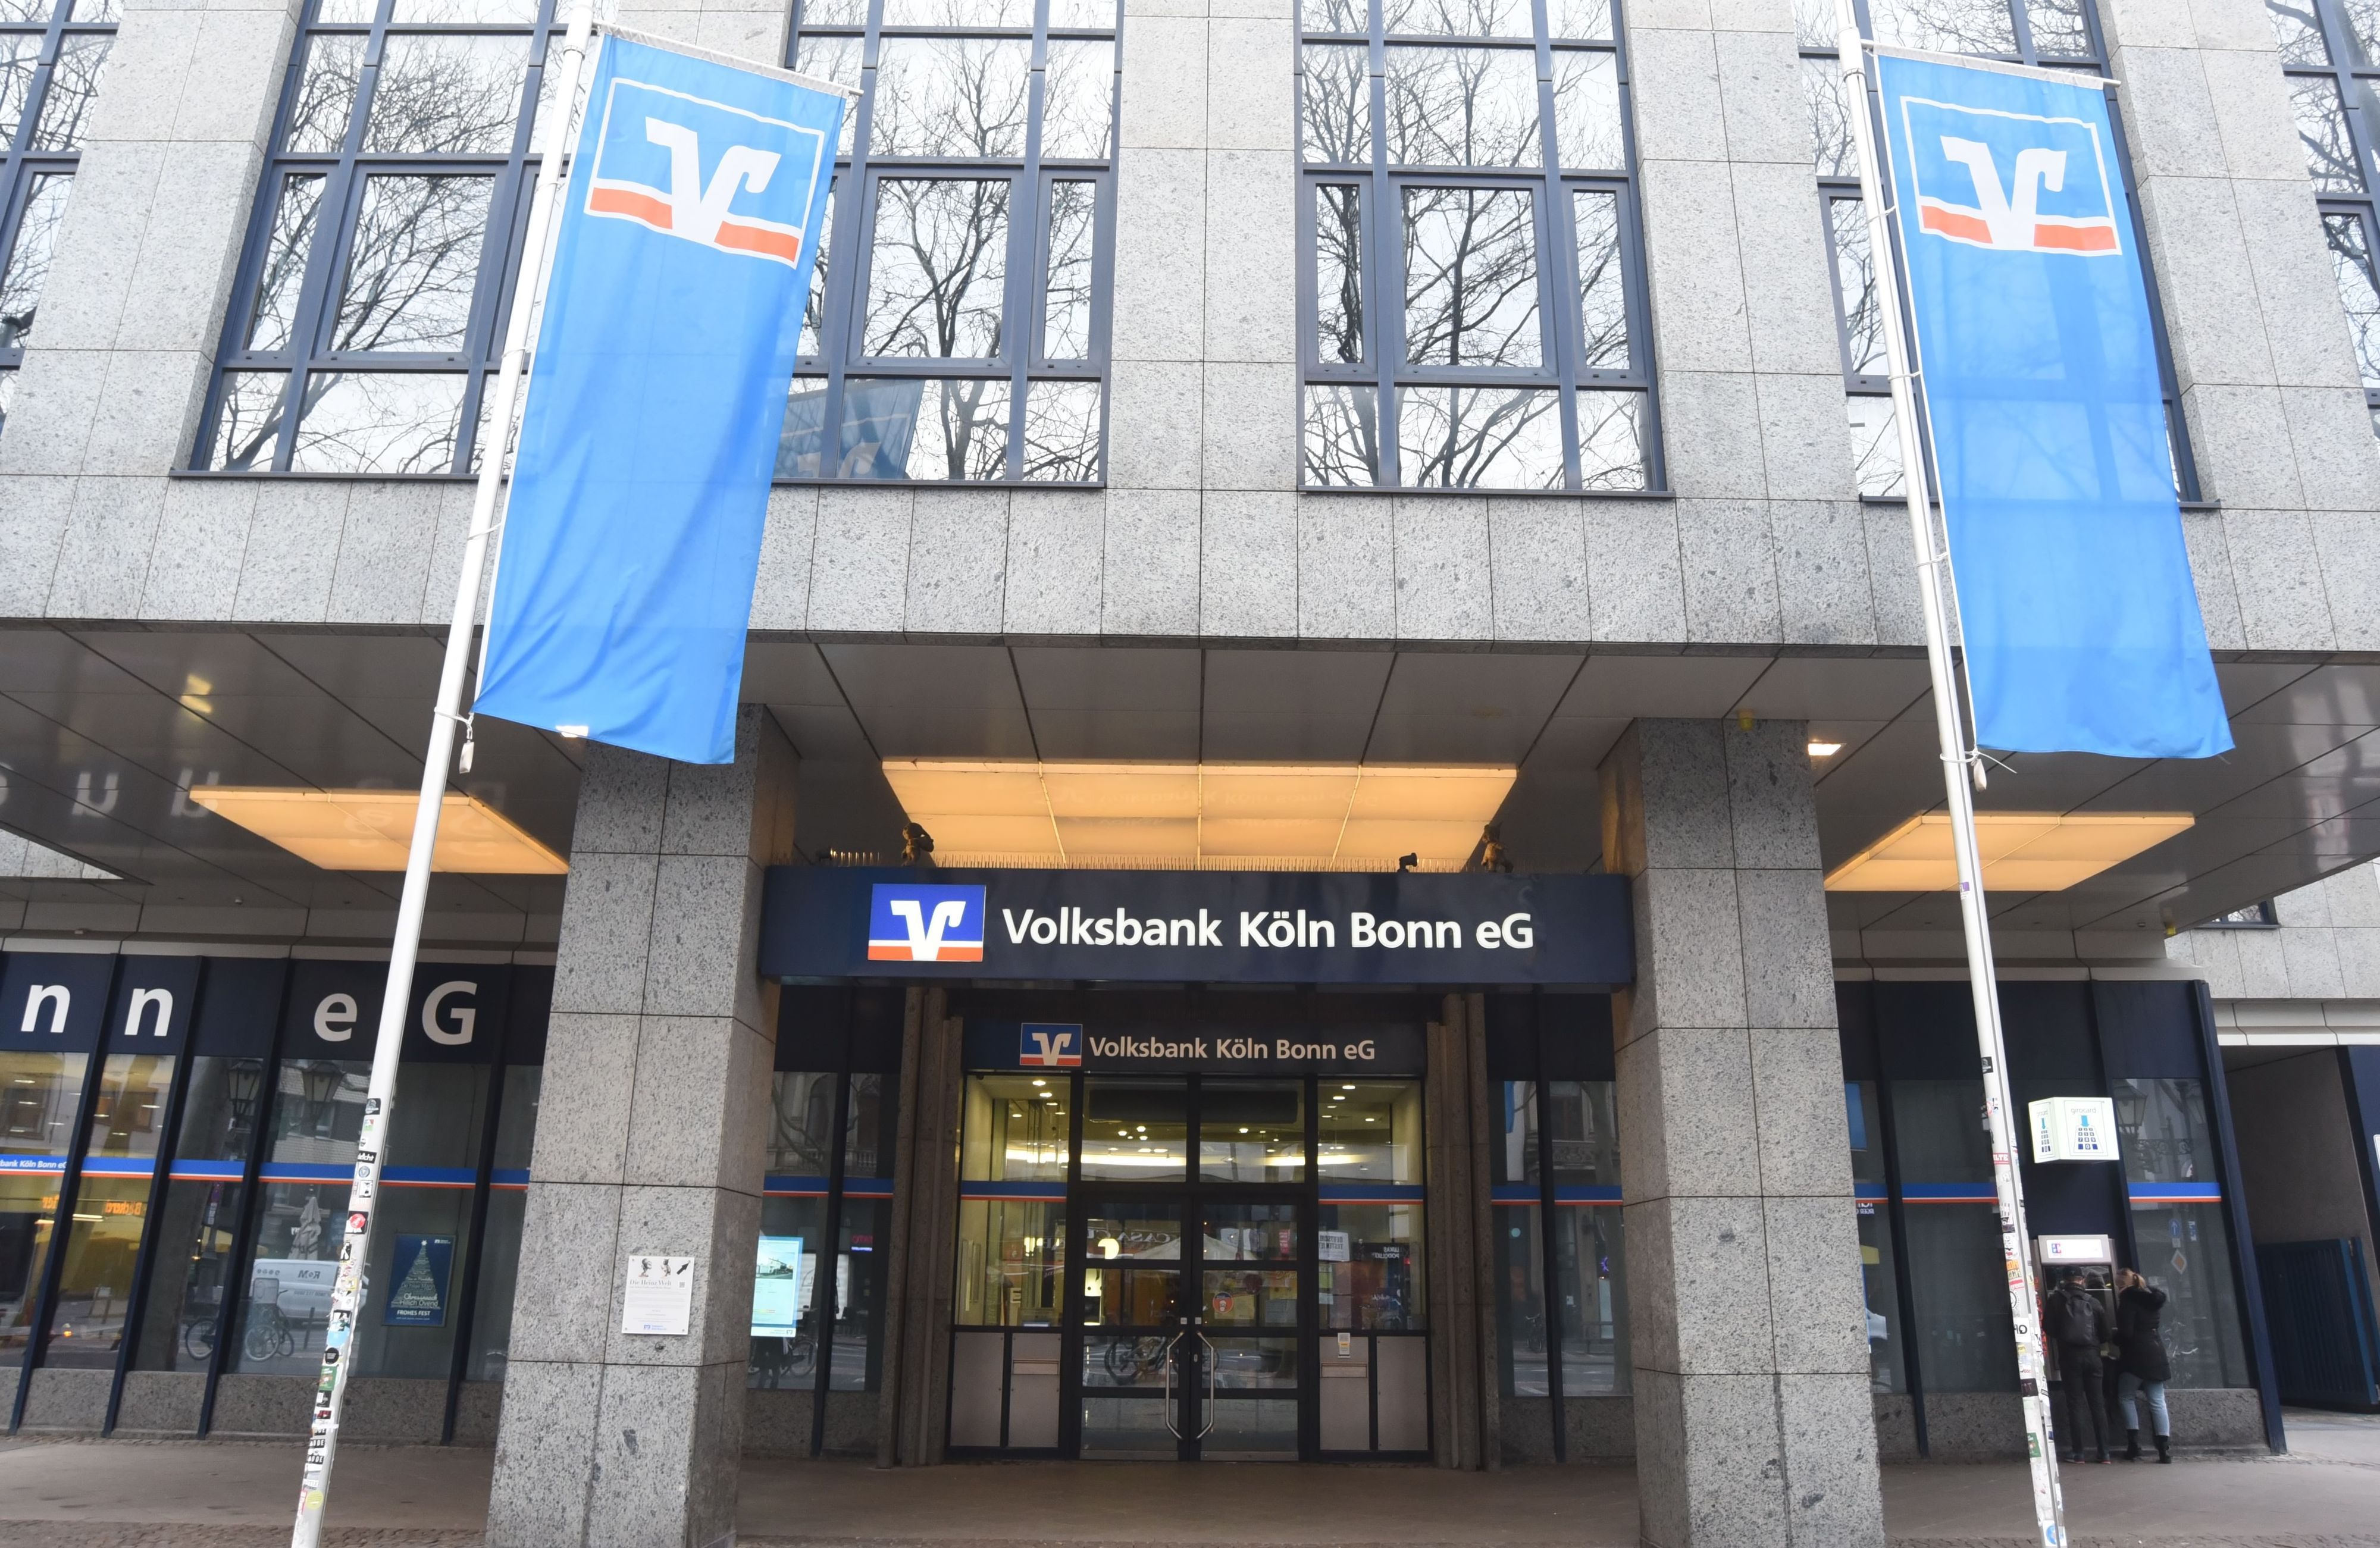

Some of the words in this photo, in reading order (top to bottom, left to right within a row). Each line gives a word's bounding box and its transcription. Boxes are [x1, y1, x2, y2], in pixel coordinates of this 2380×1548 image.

[1003, 907, 1222, 946] Volksbank
[1241, 910, 1335, 947] Köln
[1351, 913, 1461, 948] Bonn
[1476, 913, 1533, 948] eG
[1089, 1036, 1207, 1058] Volksbank
[1217, 1038, 1267, 1058] Köln
[1277, 1039, 1336, 1059] Bonn
[1345, 1040, 1374, 1060] eG
[19, 1160, 36, 1168] Köln
